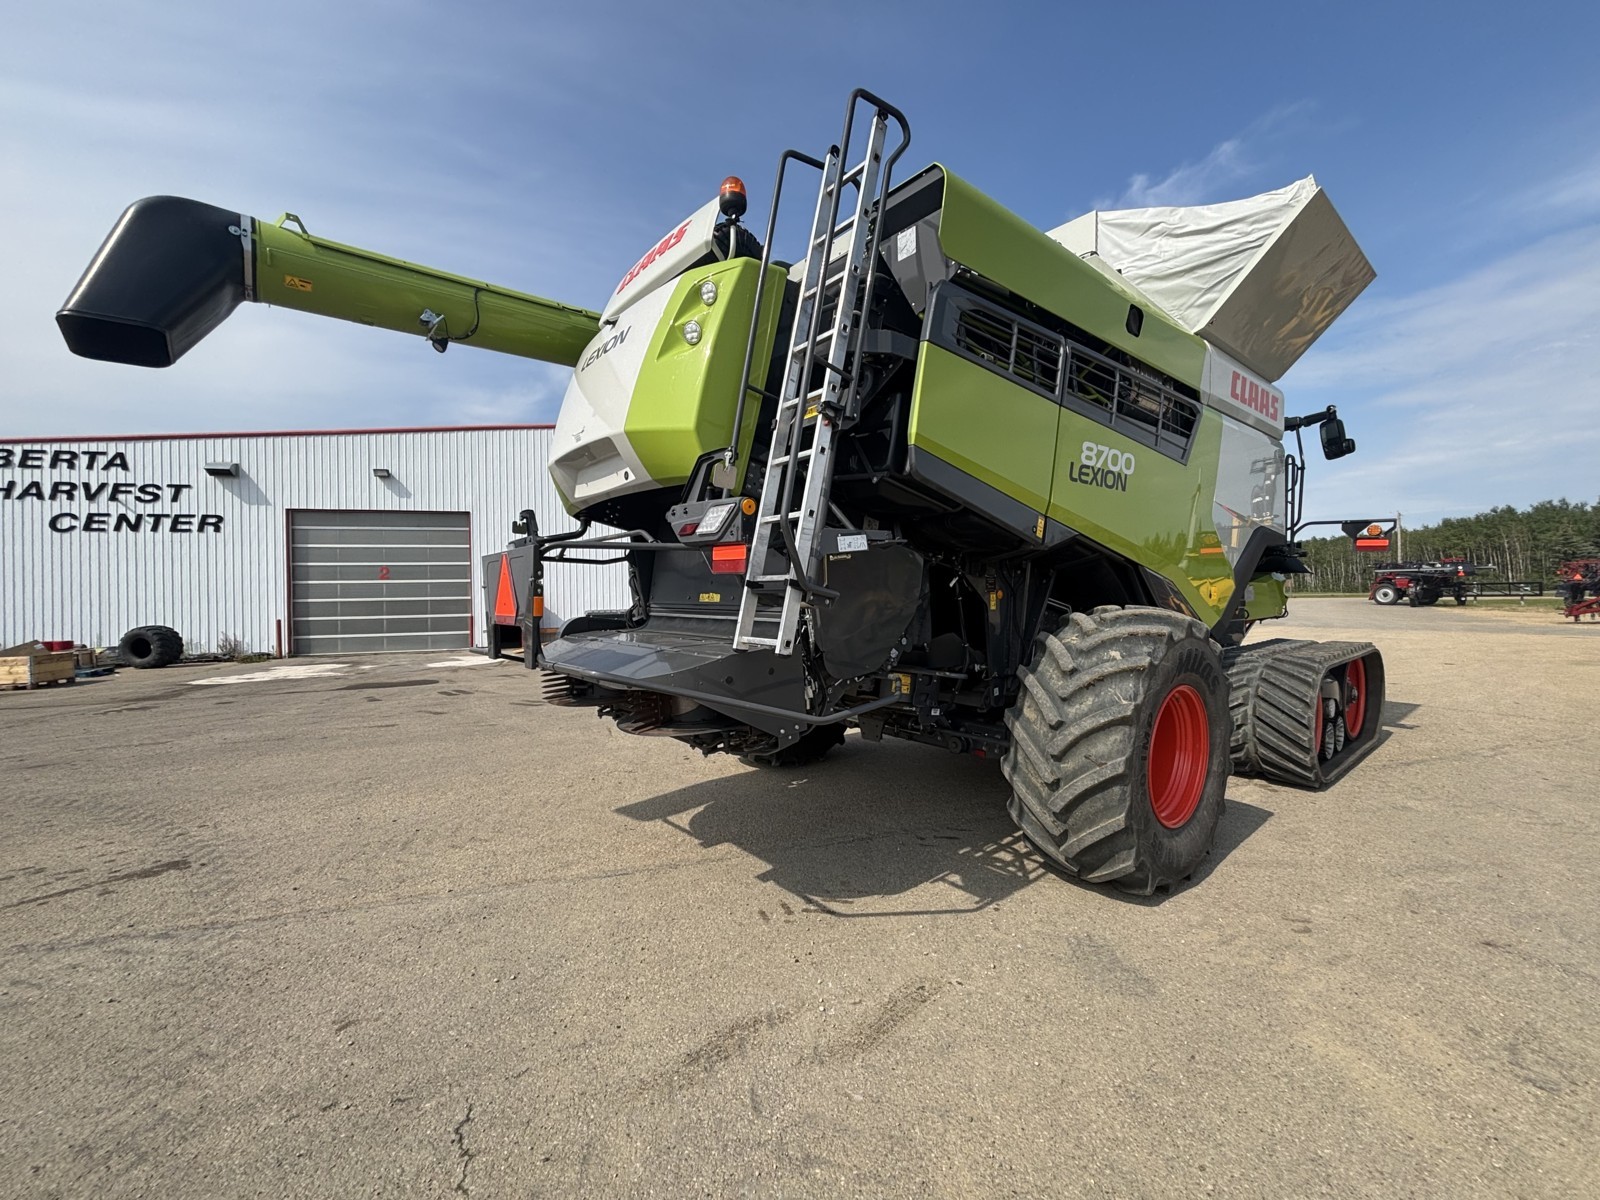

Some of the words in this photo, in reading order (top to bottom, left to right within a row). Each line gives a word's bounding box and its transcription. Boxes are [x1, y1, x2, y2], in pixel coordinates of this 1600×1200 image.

[616, 219, 693, 296] CLAAS
[580, 325, 632, 373] LEXION
[1230, 370, 1279, 422] CLAAS
[1080, 441, 1136, 475] 8700
[1068, 461, 1128, 492] LEXION
[48, 512, 224, 533] CENTER
[379, 566, 391, 580] 2
